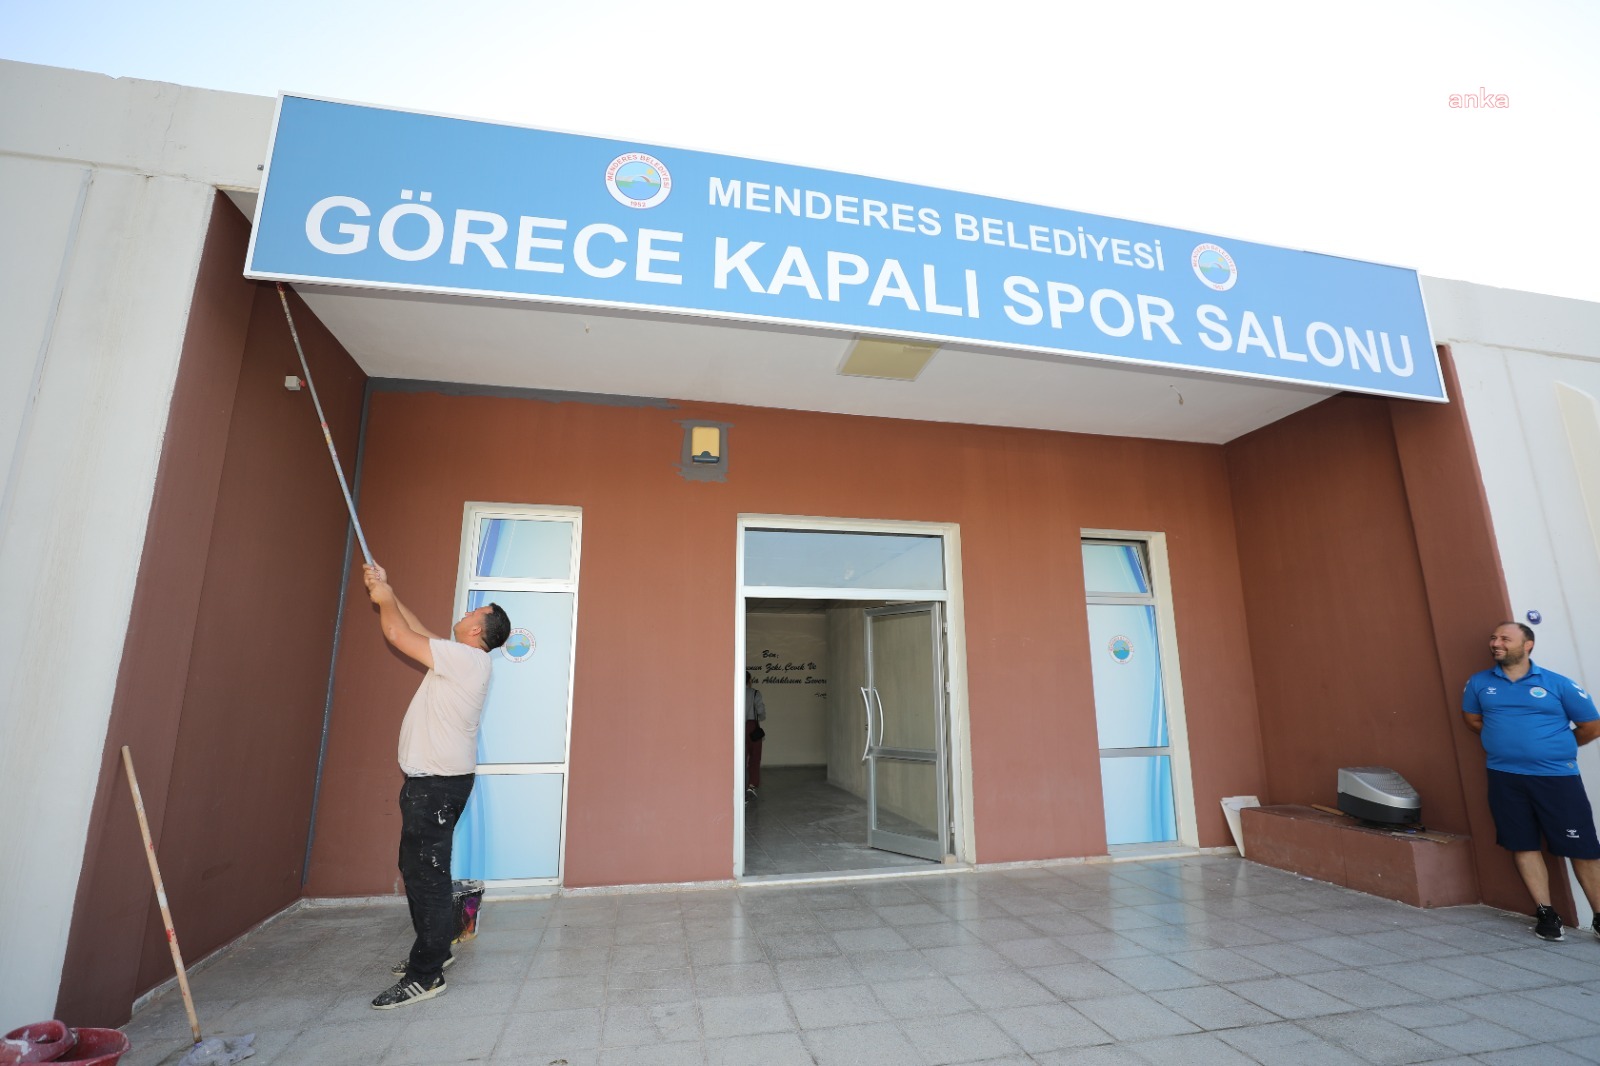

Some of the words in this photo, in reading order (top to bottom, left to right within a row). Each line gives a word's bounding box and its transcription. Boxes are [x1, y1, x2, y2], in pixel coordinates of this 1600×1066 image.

[606, 154, 638, 182] MENDERES
[708, 176, 942, 236] MENDERES
[954, 212, 1166, 271] BELEDİYESİ
[305, 189, 684, 285] GÖRECE
[712, 236, 980, 320] KAPALI
[1003, 275, 1184, 346] SPOR
[1195, 303, 1414, 379] SALONU
